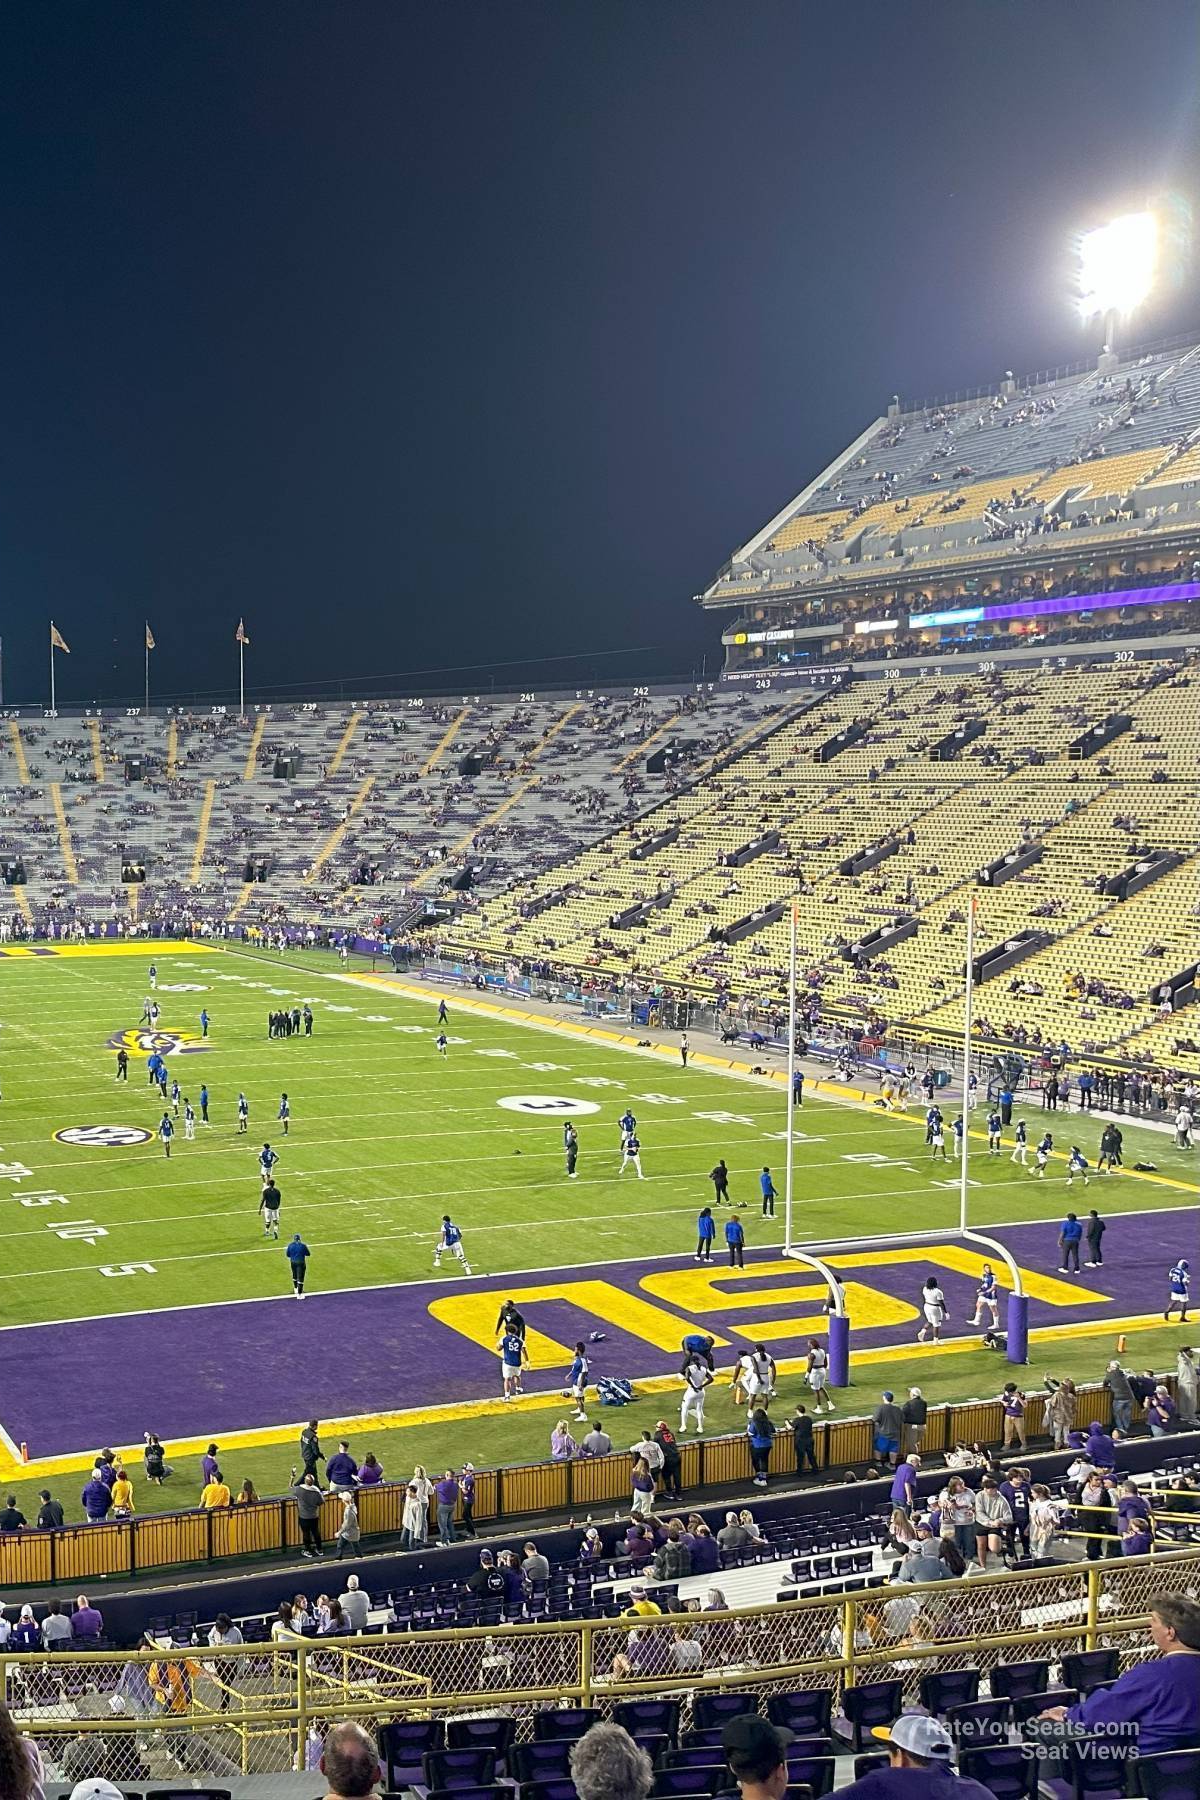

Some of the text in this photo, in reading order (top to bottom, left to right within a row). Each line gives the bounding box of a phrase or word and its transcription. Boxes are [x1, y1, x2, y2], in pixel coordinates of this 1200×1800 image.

[1113, 651, 1135, 663] 302
[978, 662, 995, 673] 301
[884, 669, 900, 679] 300
[756, 680, 771, 689] 243
[633, 686, 649, 696] 242
[520, 692, 536, 702] 241
[302, 703, 318, 712] 239
[408, 698, 424, 707] 240
[126, 708, 141, 717] 237
[211, 706, 227, 715] 238
[519, 1100, 577, 1110] 3
[11, 1189, 70, 1207] 15
[46, 1219, 109, 1239] 10
[99, 1262, 158, 1277] 5
[428, 1245, 1115, 1371] LSU
[508, 1341, 520, 1351] 52
[1014, 1491, 1025, 1508] 2
[23, 1631, 30, 1644] 1
